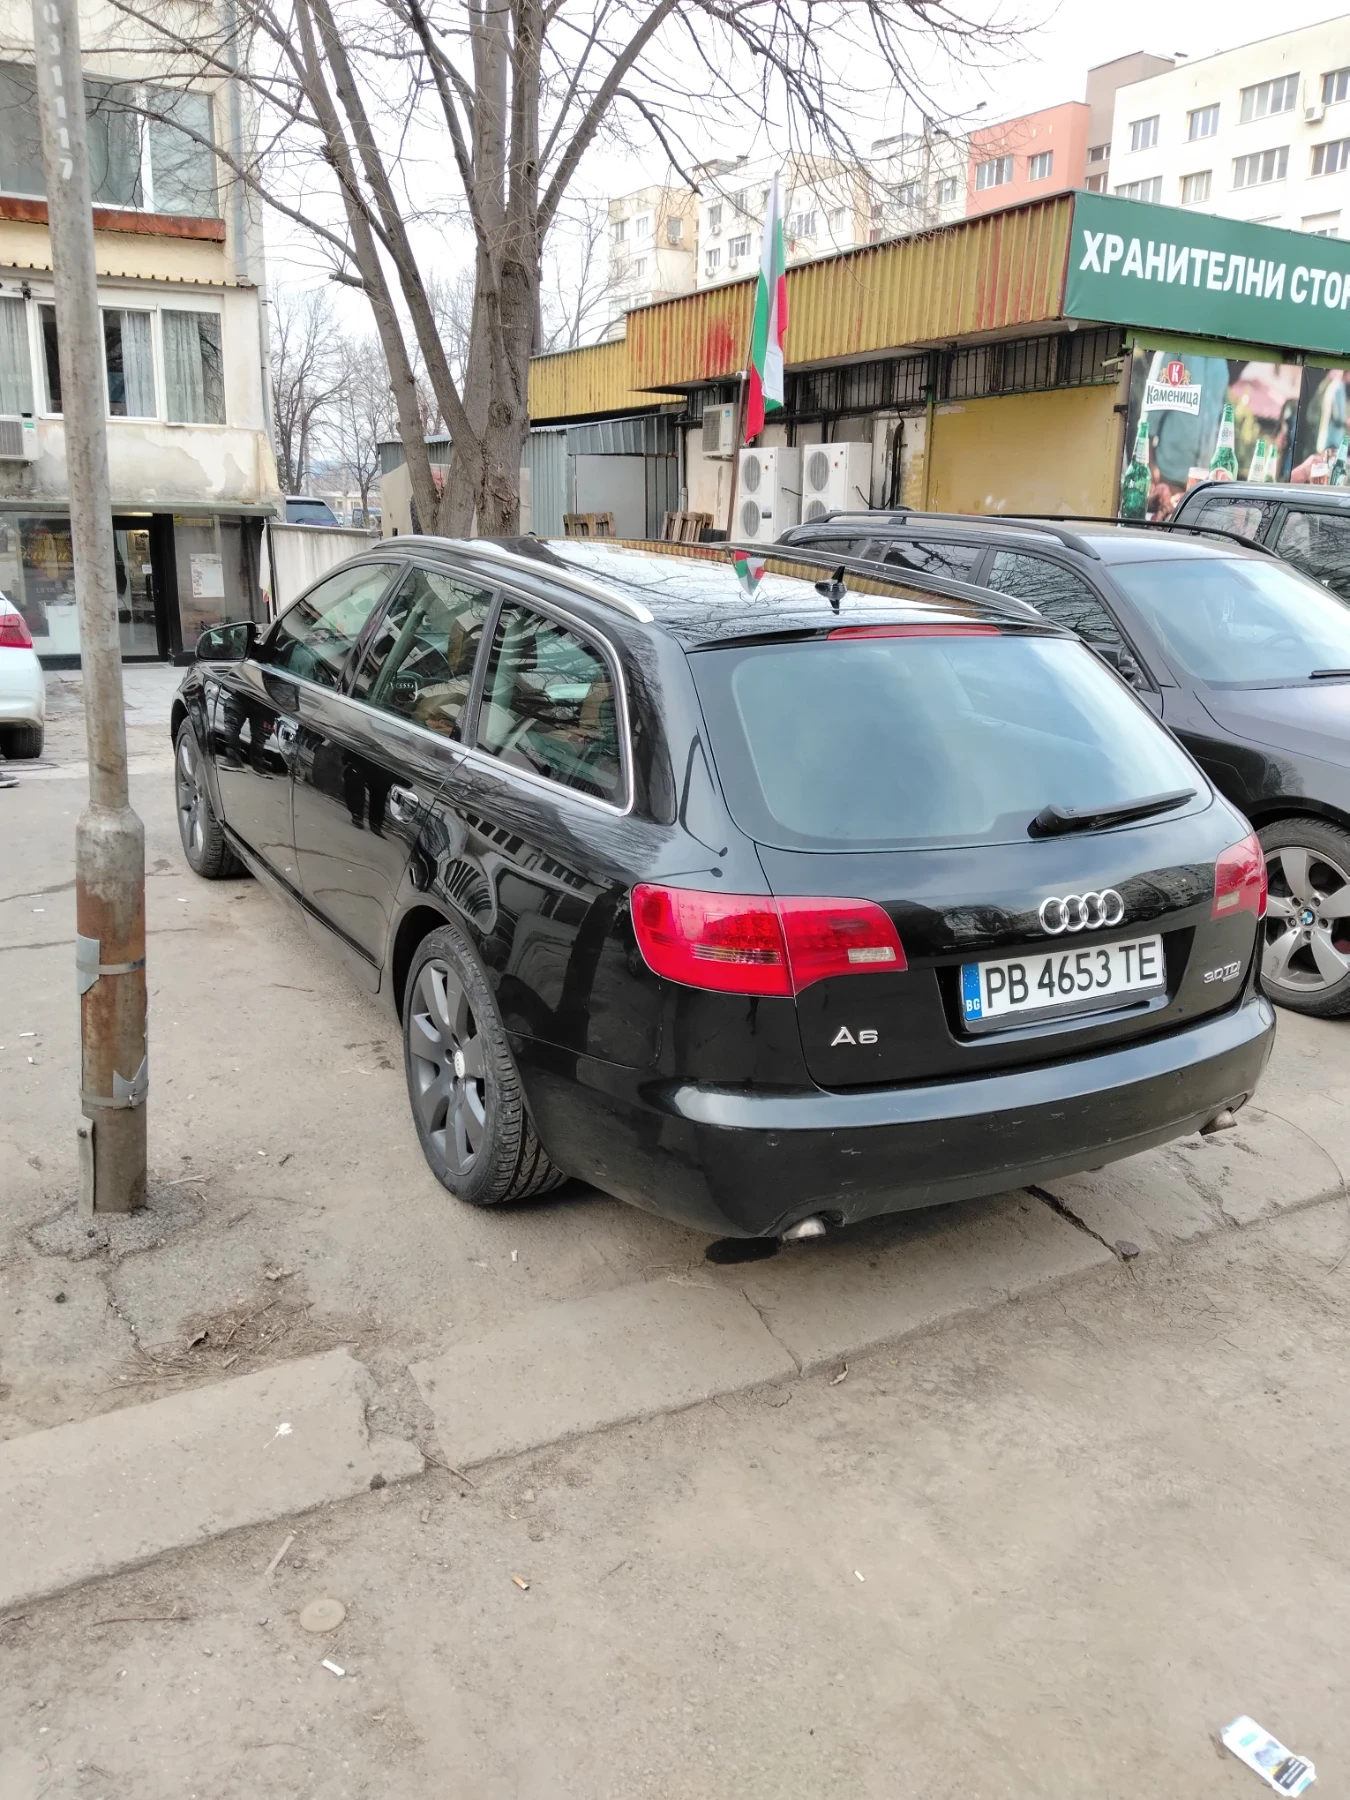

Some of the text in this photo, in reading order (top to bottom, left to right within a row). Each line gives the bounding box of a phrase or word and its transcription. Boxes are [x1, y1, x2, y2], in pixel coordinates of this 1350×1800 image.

[1079, 230, 1286, 300] ХРАНИТЕЛНИ
[1146, 385, 1199, 407] Каменица
[985, 941, 1157, 1008] PB 4653 TE
[966, 998, 981, 1012] BG
[830, 1026, 879, 1047] A6
